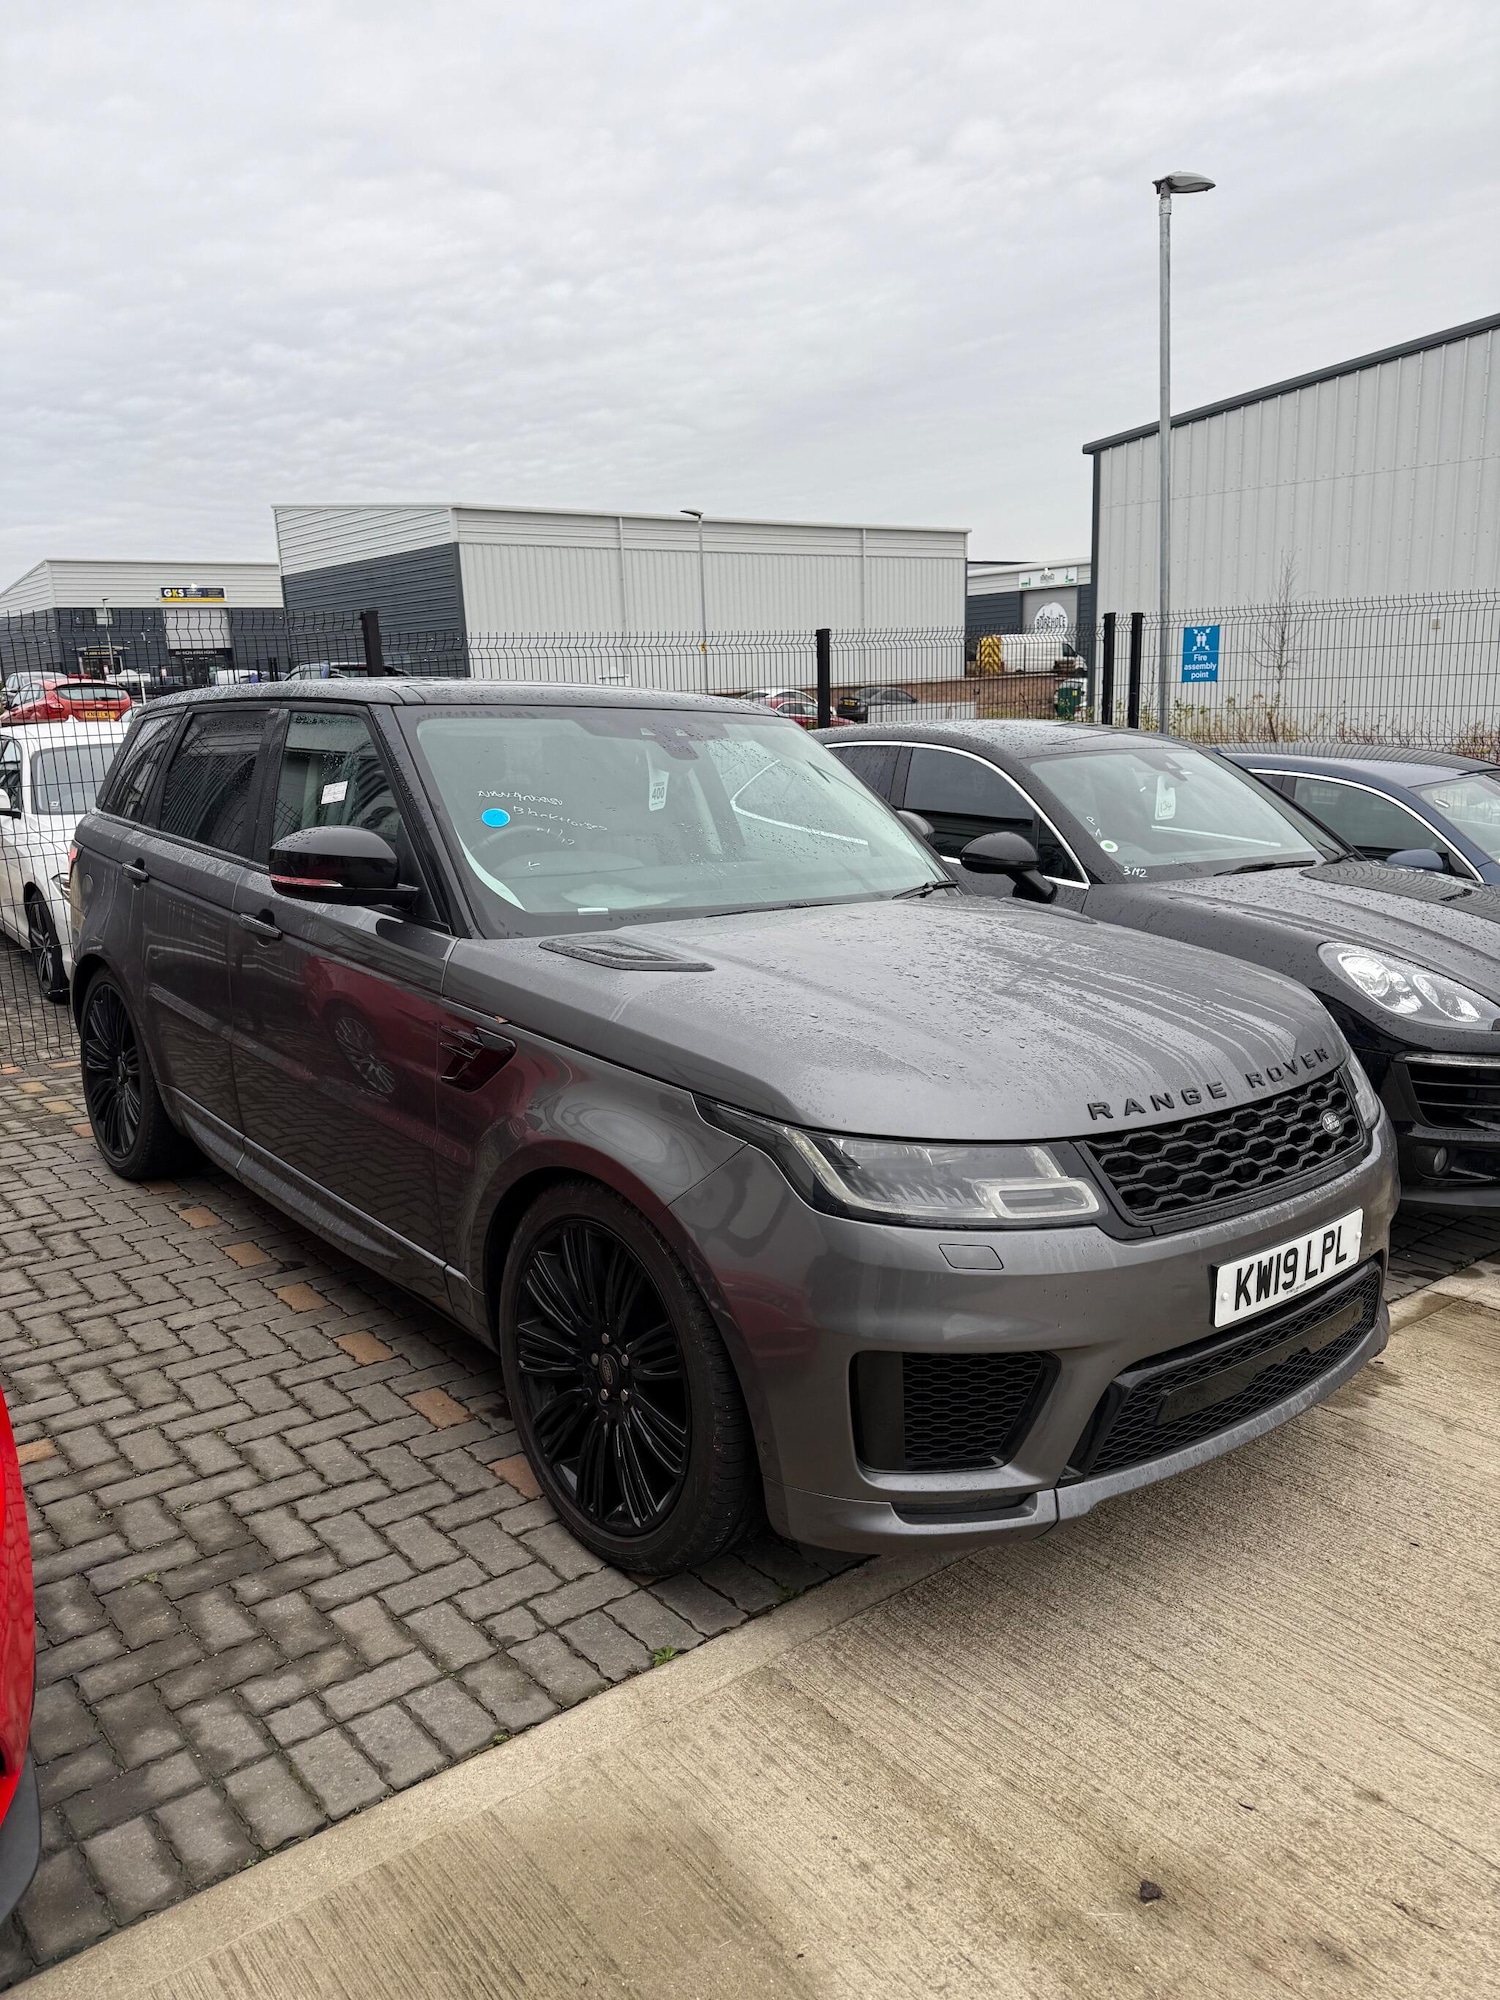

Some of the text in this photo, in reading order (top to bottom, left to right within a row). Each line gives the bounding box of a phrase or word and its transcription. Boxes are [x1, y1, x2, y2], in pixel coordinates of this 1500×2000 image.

[164, 588, 184, 597] GKS
[1184, 662, 1217, 671] assembly
[1191, 671, 1209, 680] point
[652, 786, 665, 800] 400
[1087, 1047, 1329, 1120] RANGE ROVER
[1234, 1225, 1348, 1311] KW19 LPL
